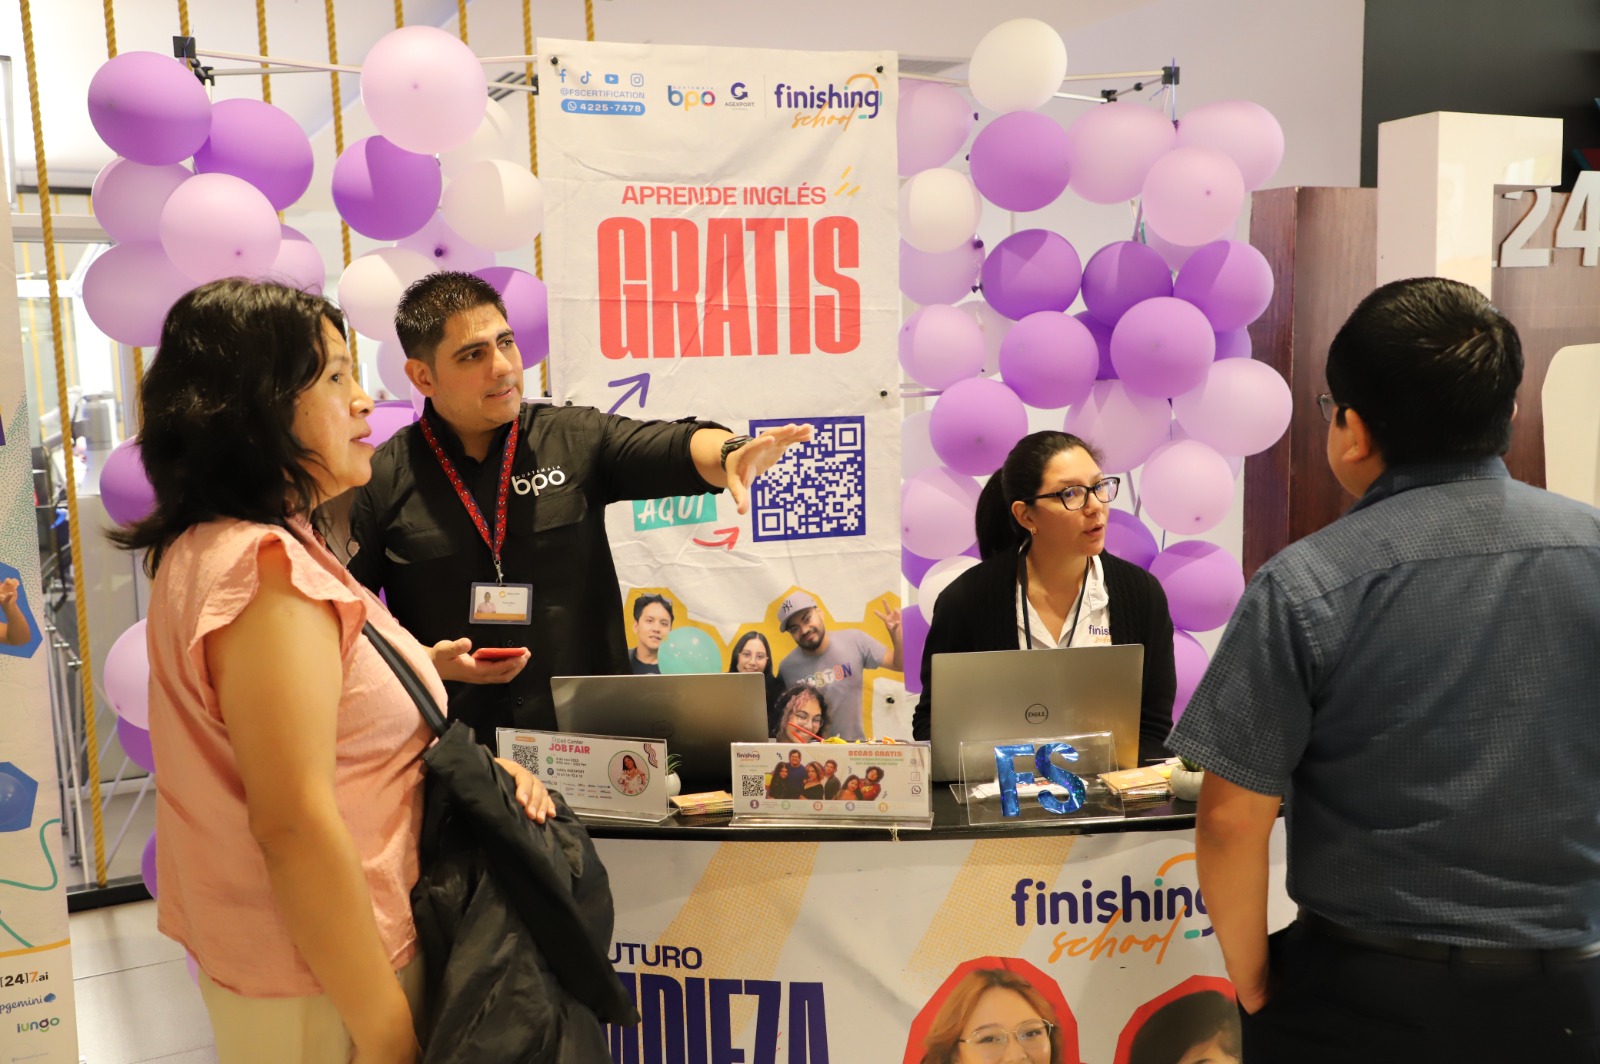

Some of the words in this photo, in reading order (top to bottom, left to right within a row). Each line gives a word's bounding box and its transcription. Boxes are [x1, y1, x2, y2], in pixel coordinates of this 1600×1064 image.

[560, 87, 645, 99] @FSCERTIFICATION
[667, 85, 716, 111] bpo
[774, 83, 879, 119] finishing
[580, 103, 642, 113] 4225-7478
[791, 101, 859, 132] school
[621, 185, 737, 206] APRENDE
[743, 182, 827, 206] INGLÉS
[597, 215, 861, 360] GRATIS
[511, 470, 566, 497] bpo
[1088, 624, 1111, 636] finis
[549, 743, 568, 753] JOB
[569, 744, 591, 755] FAIR
[994, 742, 1087, 817] FS
[1047, 905, 1187, 965] school
[17, 1017, 60, 1033] iungo
